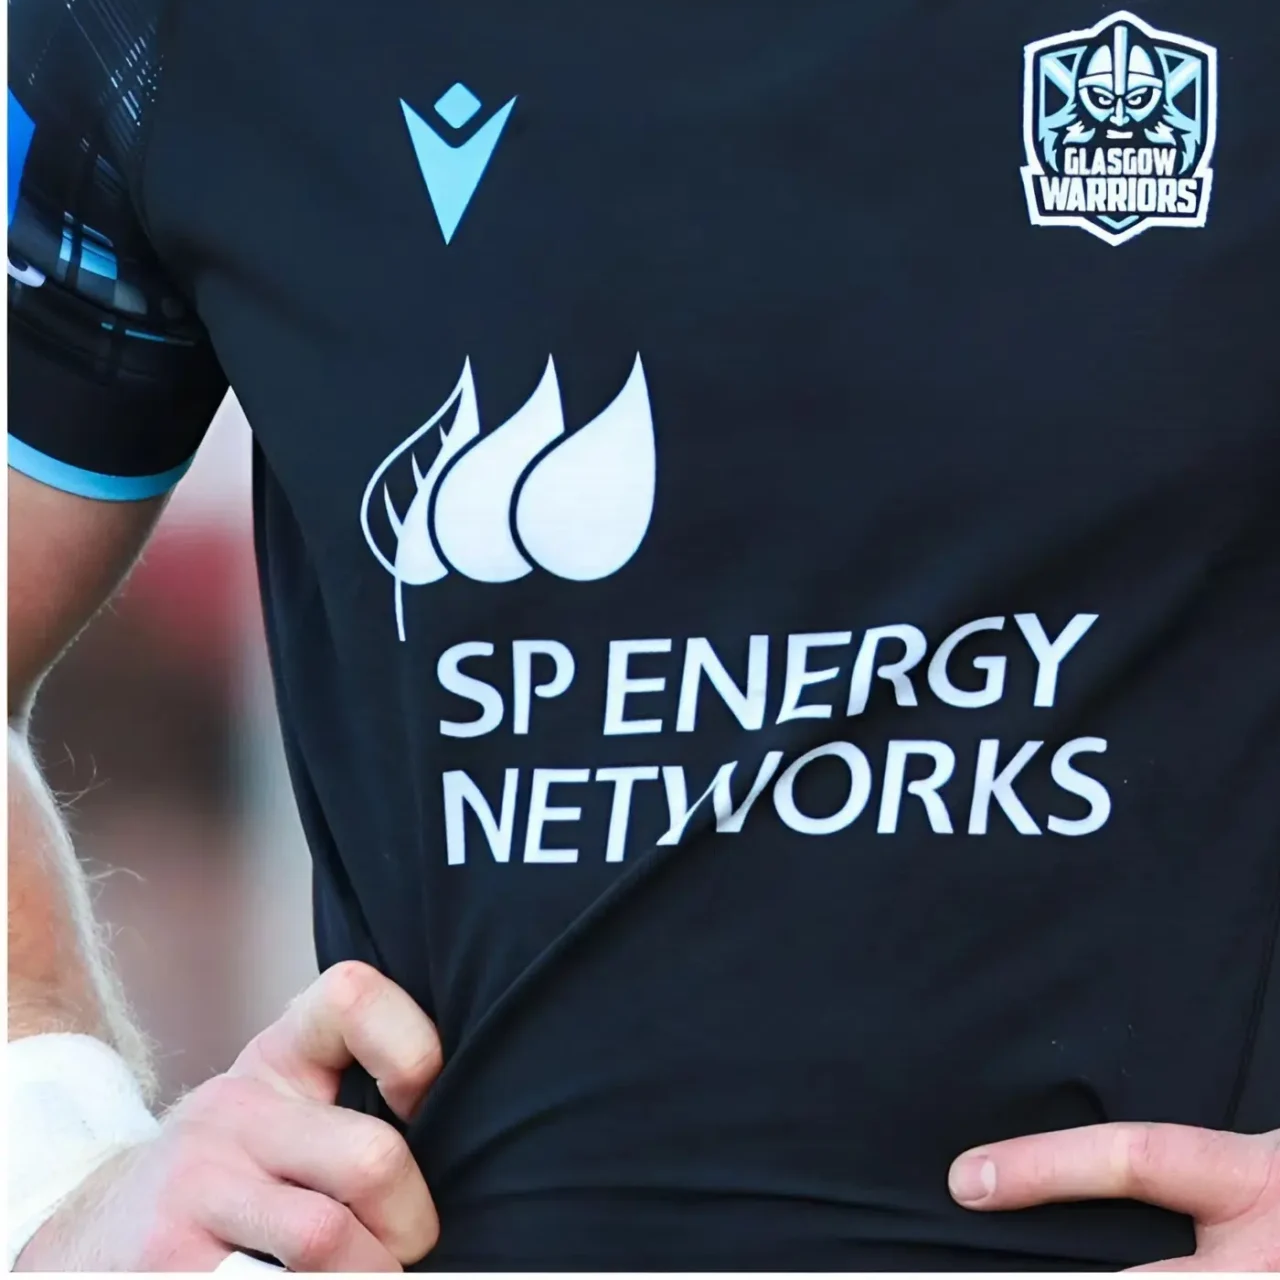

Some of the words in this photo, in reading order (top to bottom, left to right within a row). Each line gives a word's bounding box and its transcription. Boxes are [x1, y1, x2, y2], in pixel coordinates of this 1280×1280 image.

[1040, 176, 1198, 214] WARRIORS
[1064, 146, 1177, 177] GLASGOW
[436, 639, 576, 739] SP
[603, 613, 1099, 736] ENERGY
[442, 736, 1111, 866] NETWORKS
